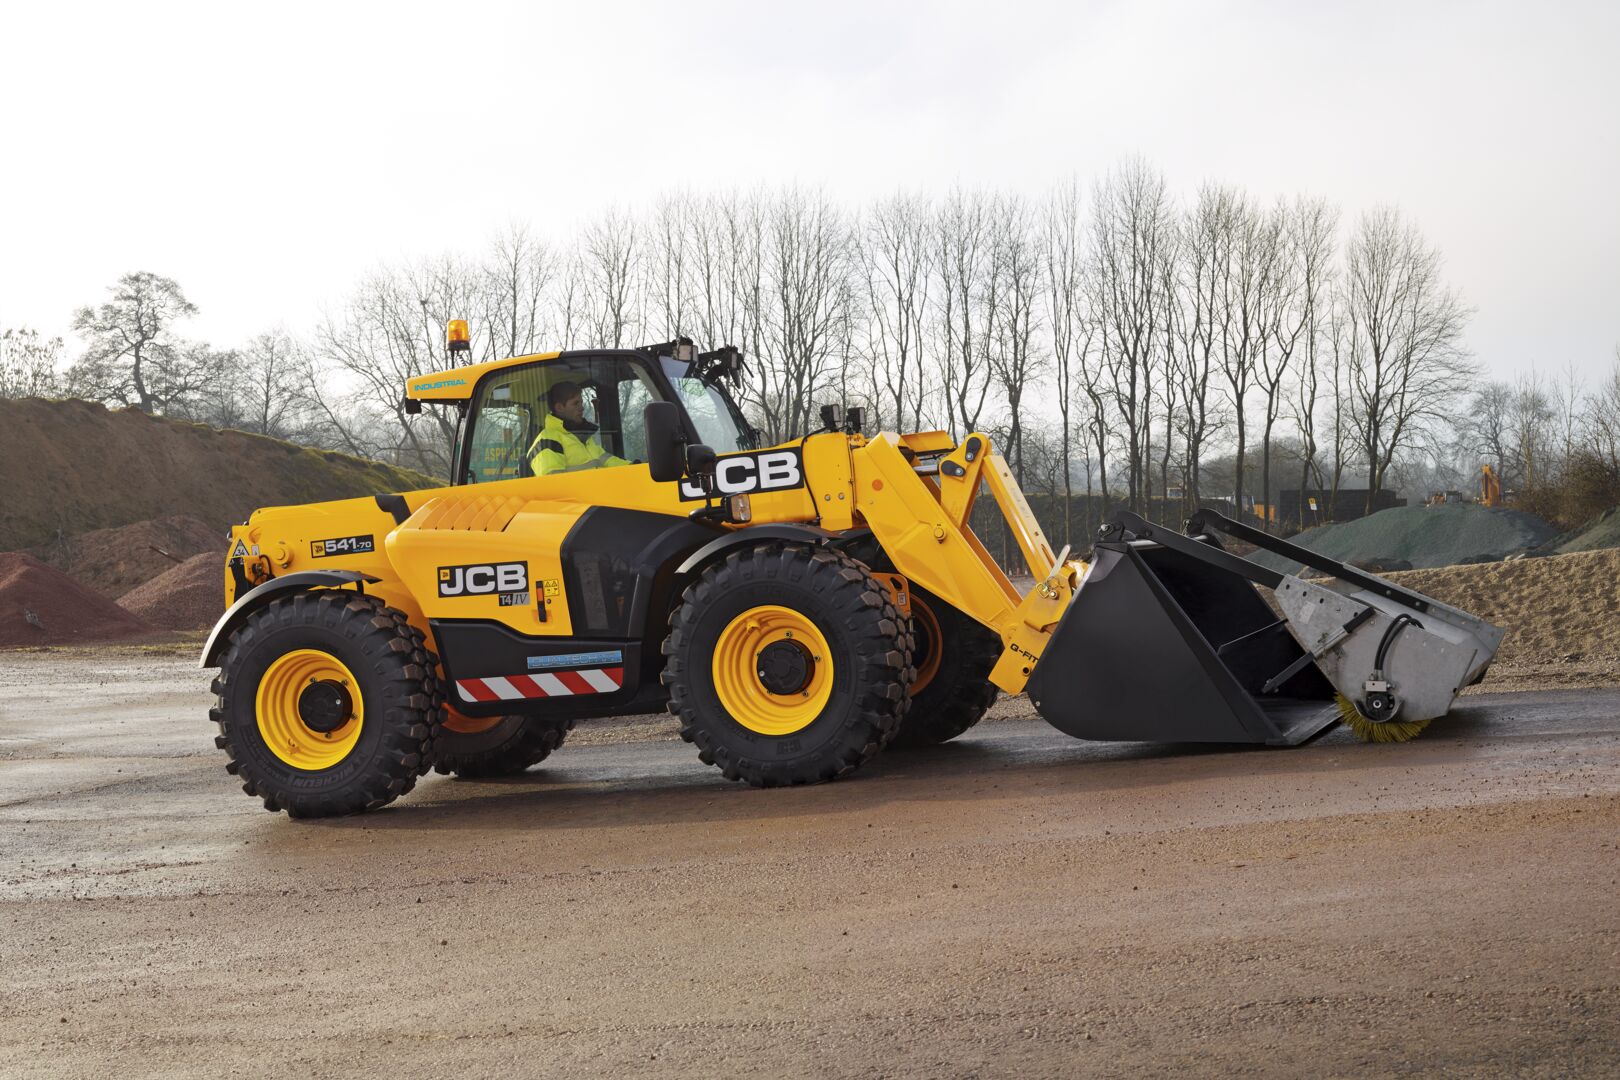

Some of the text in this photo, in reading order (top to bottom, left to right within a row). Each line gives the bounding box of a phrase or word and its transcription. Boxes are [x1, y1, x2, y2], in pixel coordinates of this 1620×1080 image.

[414, 379, 467, 391] INDUSTRIAL
[440, 564, 527, 595] JCB
[500, 594, 513, 605] T4
